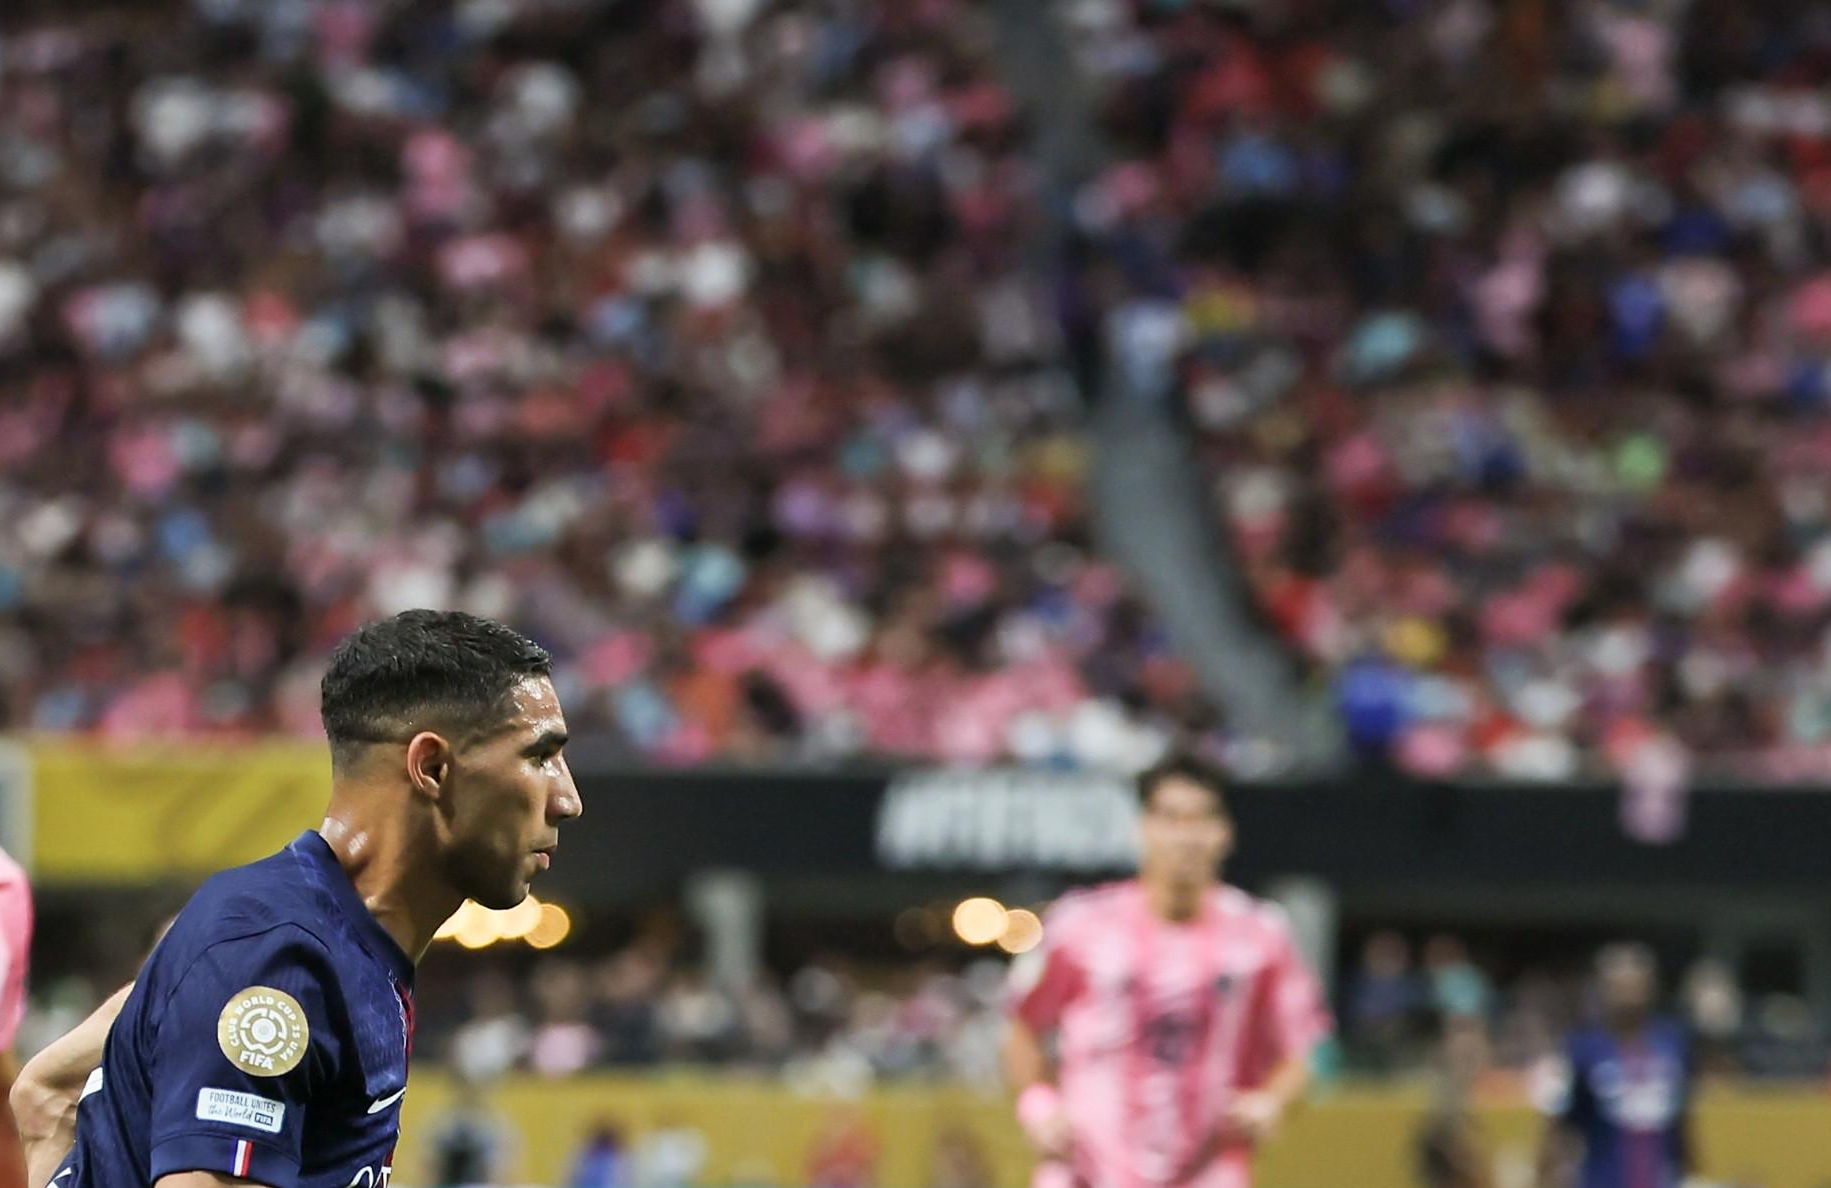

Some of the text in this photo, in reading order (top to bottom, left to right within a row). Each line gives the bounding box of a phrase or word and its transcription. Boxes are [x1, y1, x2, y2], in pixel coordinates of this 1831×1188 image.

[235, 995, 275, 1015] WORLD
[277, 1001, 297, 1021] CUP
[239, 1050, 275, 1070] FIFA
[279, 1041, 299, 1061] USA
[209, 1091, 277, 1114] FOOTBALL UNITES
